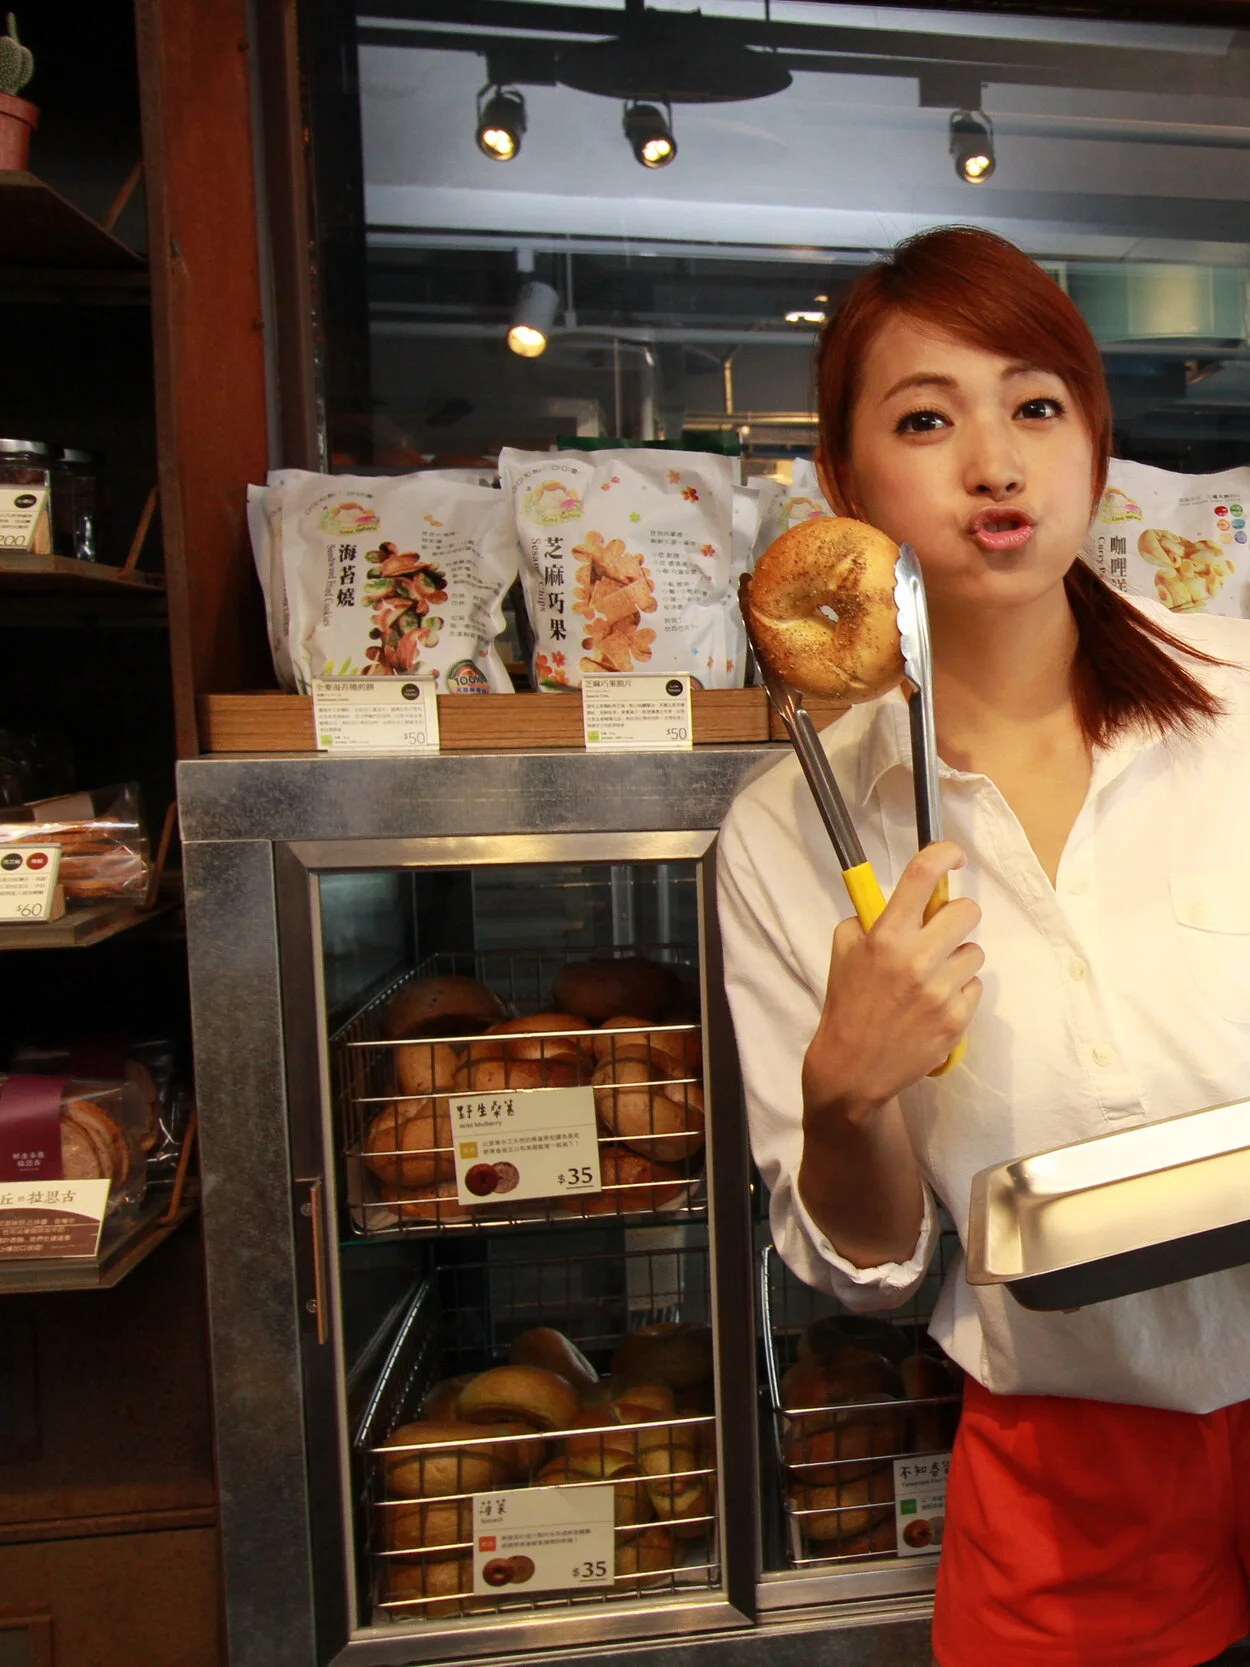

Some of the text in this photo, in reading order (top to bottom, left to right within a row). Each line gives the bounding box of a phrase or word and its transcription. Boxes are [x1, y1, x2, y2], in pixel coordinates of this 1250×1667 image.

[336, 543, 358, 608] 海苔燒
[543, 537, 568, 642] 芝麻巧果
[404, 732, 425, 745] $50
[667, 728, 687, 740] $50
[16, 903, 42, 917] $60
[474, 1120, 502, 1128] Mulberry
[558, 1167, 594, 1185] $35
[572, 1561, 607, 1579] $35
